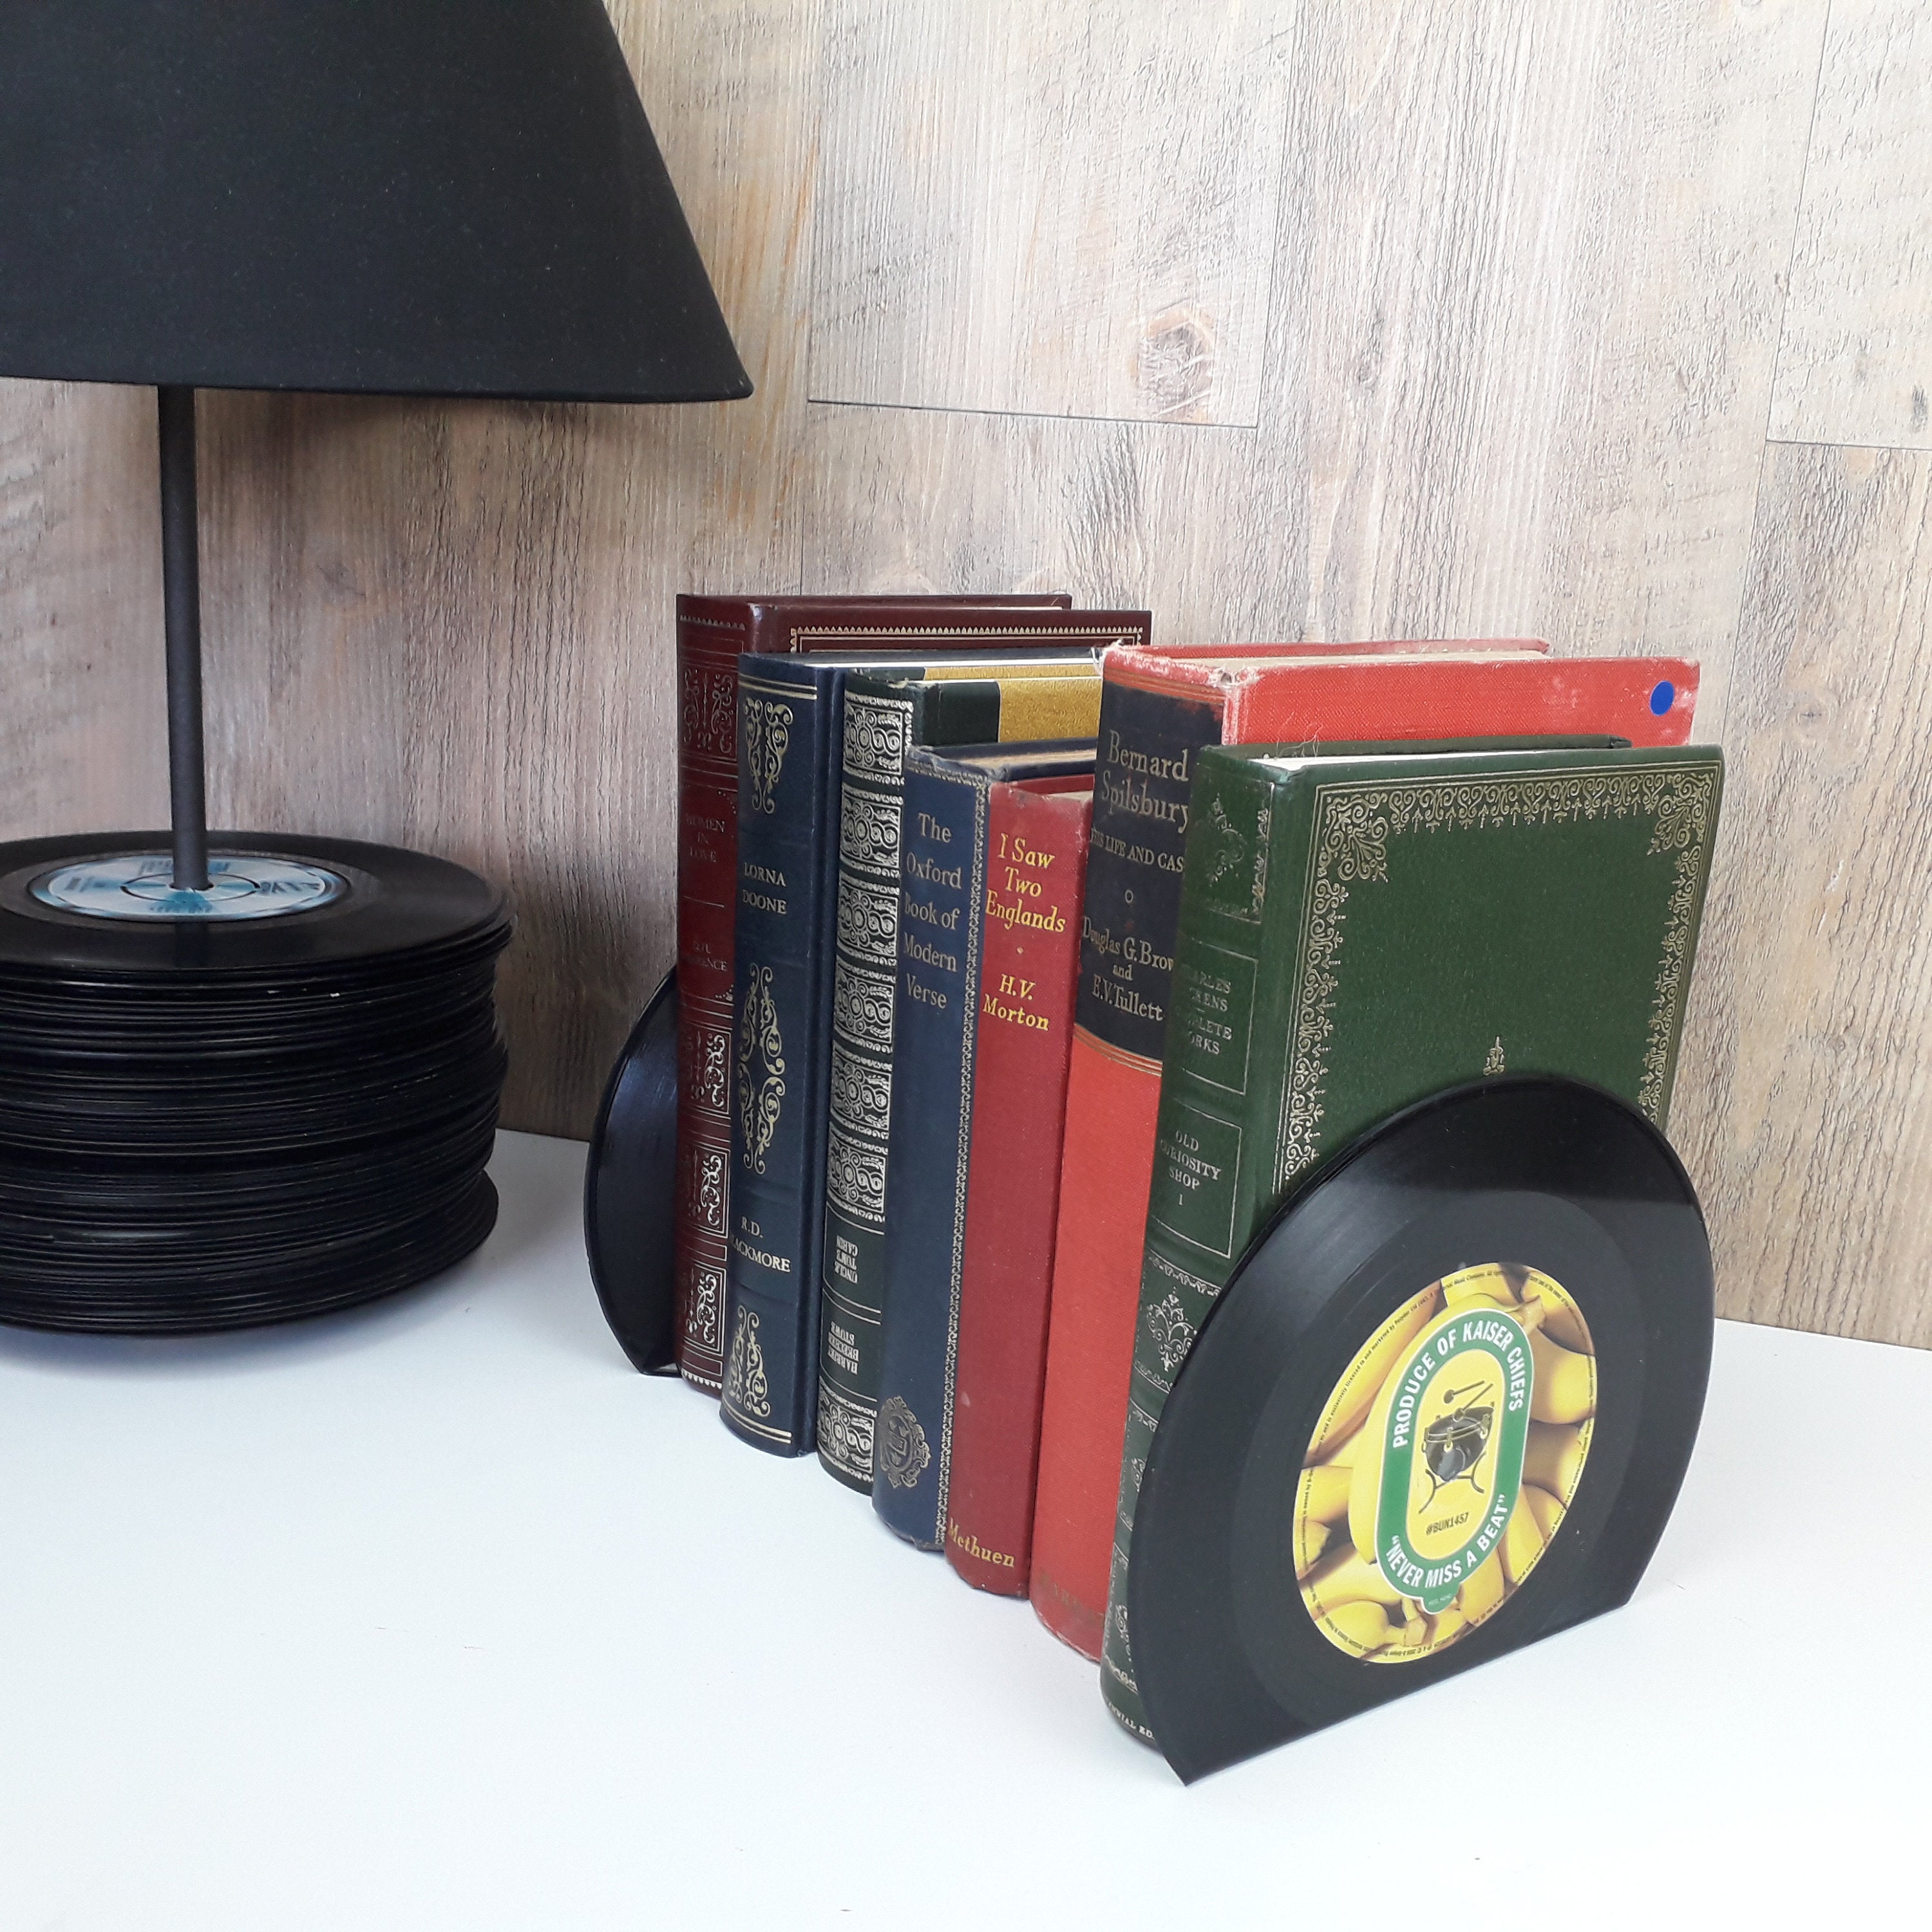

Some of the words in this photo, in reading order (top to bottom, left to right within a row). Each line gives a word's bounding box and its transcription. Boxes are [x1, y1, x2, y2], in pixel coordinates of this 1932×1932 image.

[1108, 729, 1189, 782] Bernard
[1102, 770, 1189, 834] Spilsbury
[918, 812, 952, 843] The
[906, 851, 962, 889] Oxford
[998, 833, 1009, 858] I
[1012, 837, 1056, 869] Saw
[1104, 835, 1126, 857] LIFE
[1128, 845, 1155, 865] AND
[1158, 853, 1185, 873] CAS
[744, 862, 787, 887] LORNA
[1005, 866, 1043, 898] Two
[743, 889, 788, 914] DOONE
[904, 891, 938, 925] Book
[941, 907, 961, 931] of
[985, 889, 1067, 933] Englands
[904, 932, 958, 972] Modern
[1083, 915, 1121, 954] Douglas
[906, 973, 947, 1010] Verse
[1113, 964, 1133, 981] and
[983, 994, 1050, 1032] Morton
[1189, 1031, 1220, 1055] ORKS
[1175, 1130, 1199, 1151] OLD
[1169, 1166, 1200, 1190] SHOP
[741, 1215, 763, 1238] R.D.
[1392, 1352, 1436, 1448] PRODUCE
[1437, 1328, 1457, 1356] OF
[1463, 1320, 1514, 1352] KAISER
[1507, 1347, 1526, 1411] CHIEFS
[948, 1517, 1016, 1567] Methuen
[1425, 1559, 1462, 1588] MISS
[1466, 1549, 1478, 1568] A
